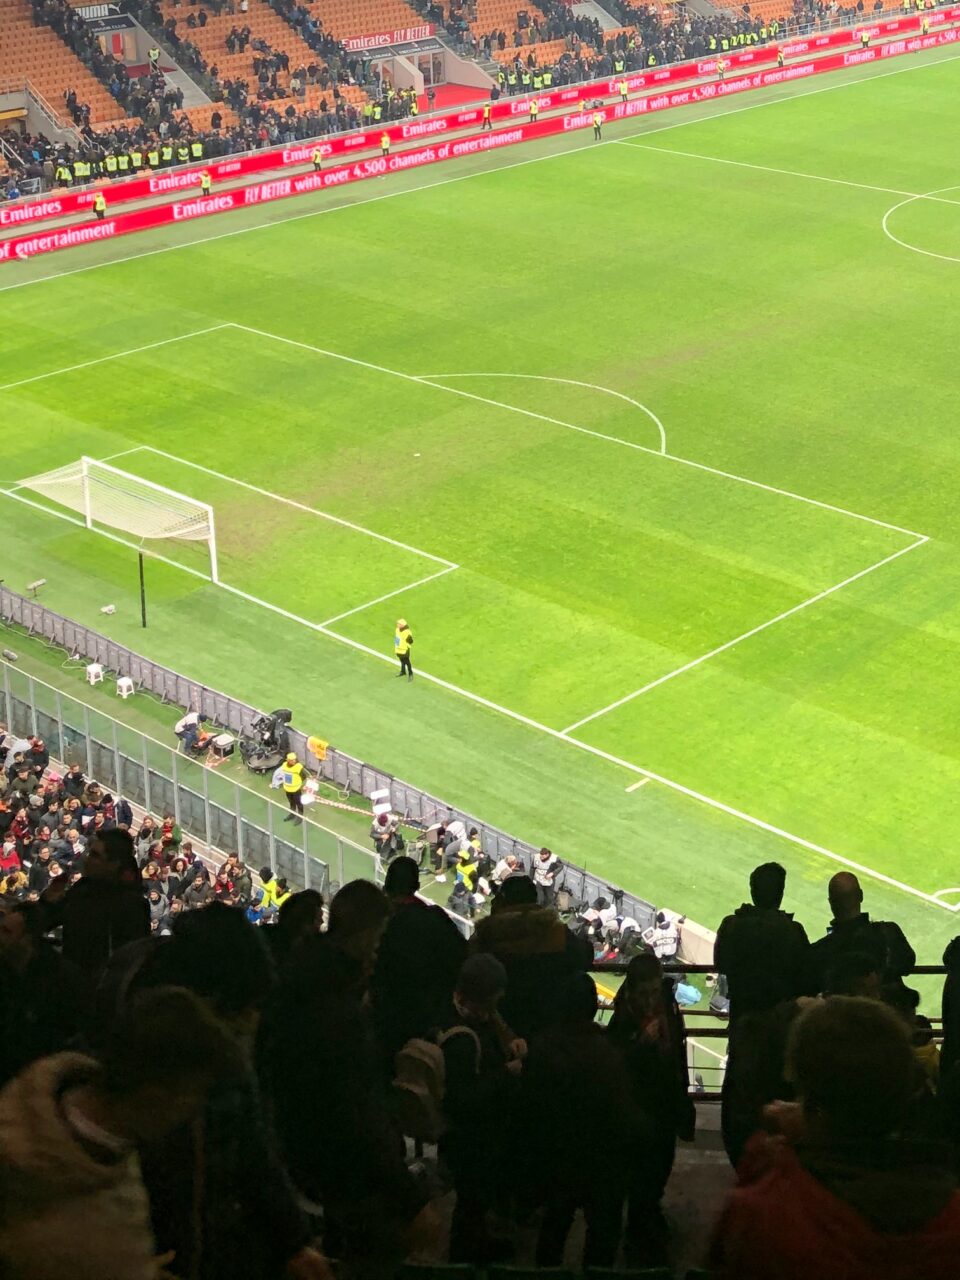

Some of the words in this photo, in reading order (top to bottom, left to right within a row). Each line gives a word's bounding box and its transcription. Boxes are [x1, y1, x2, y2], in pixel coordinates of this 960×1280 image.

[342, 32, 390, 50] Emirates
[394, 29, 405, 42] FLY
[406, 25, 430, 40] BETTER
[844, 50, 876, 65] Emirates
[650, 96, 669, 109] with
[671, 92, 690, 105] over
[717, 77, 752, 94] channels
[752, 72, 763, 87] of
[763, 64, 814, 83] entertainment
[403, 120, 447, 138] Emirates
[150, 171, 202, 192] Emirates
[173, 195, 233, 219] Emirates
[244, 187, 259, 204] FLY
[261, 179, 291, 200] BETTER
[295, 174, 321, 192] with
[323, 169, 350, 186] over
[353, 160, 387, 180] 4,500
[388, 148, 436, 171] channels
[437, 142, 451, 158] of
[452, 130, 523, 155] entertainment
[1, 200, 62, 223] Emirates
[15, 222, 115, 256] entertainment
